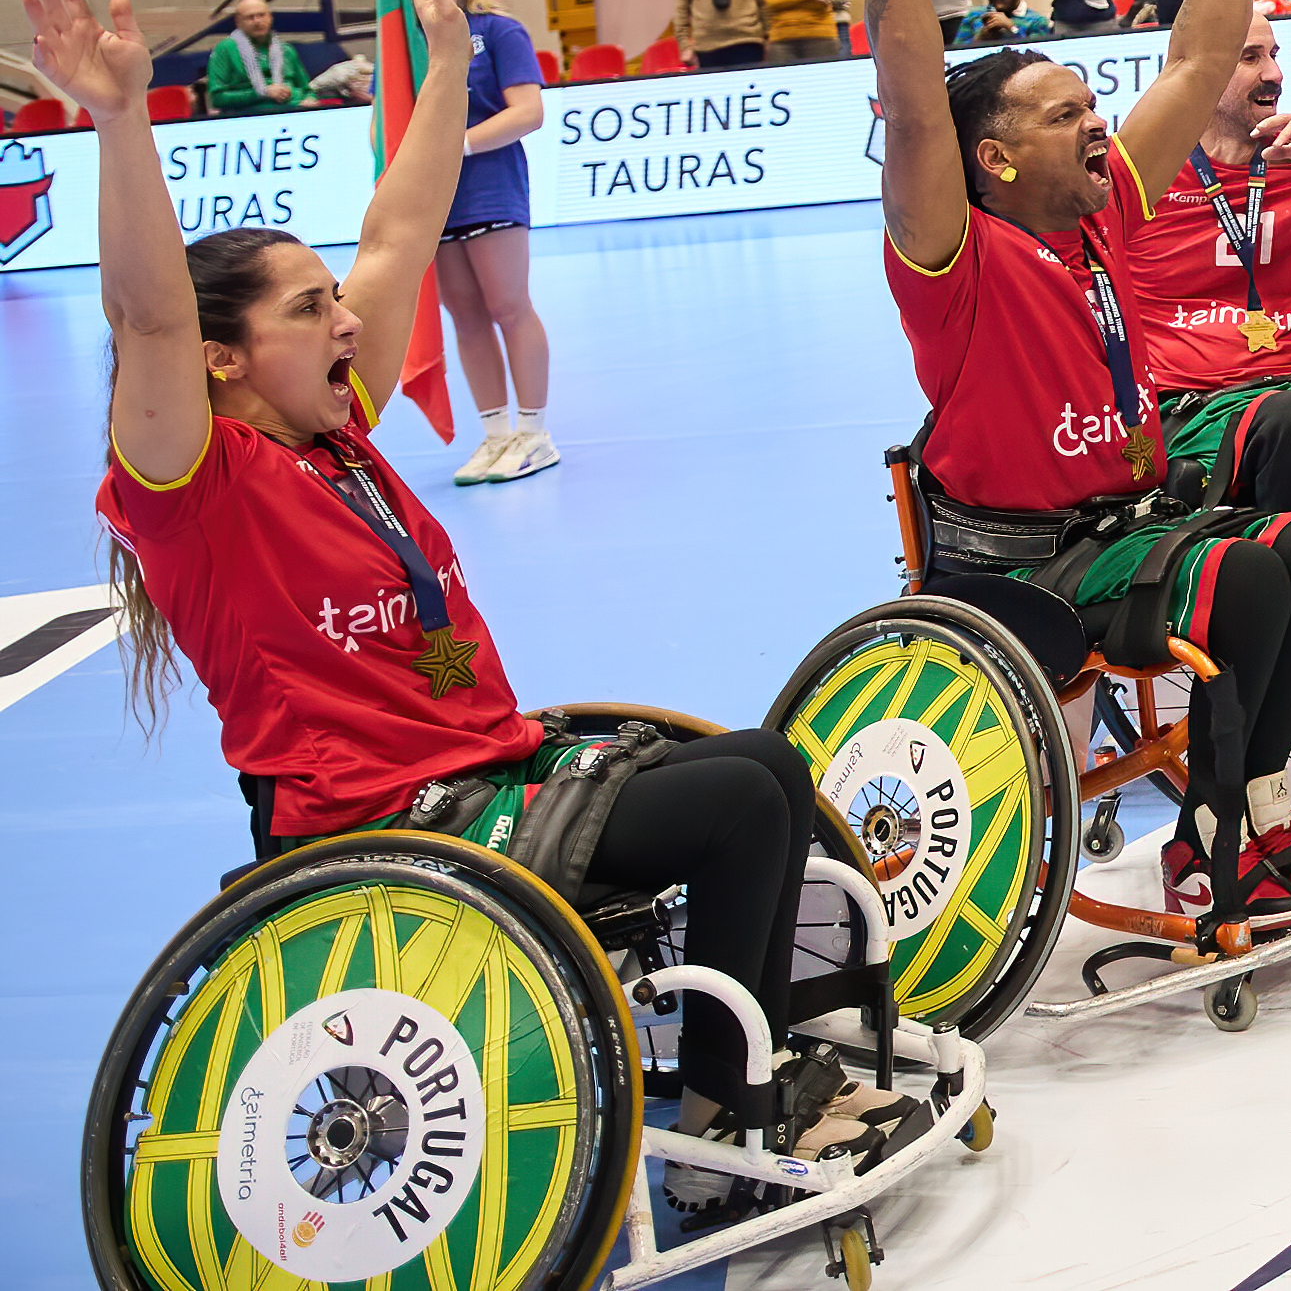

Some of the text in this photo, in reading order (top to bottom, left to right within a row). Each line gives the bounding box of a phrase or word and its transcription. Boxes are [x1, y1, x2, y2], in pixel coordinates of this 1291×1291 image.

[561, 83, 793, 146] SOSTINĖS
[582, 148, 766, 198] TAURAS
[882, 778, 959, 927] PORTUGA
[372, 1014, 468, 1244] PORTUGAL
[277, 1202, 288, 1262] andebol4all
